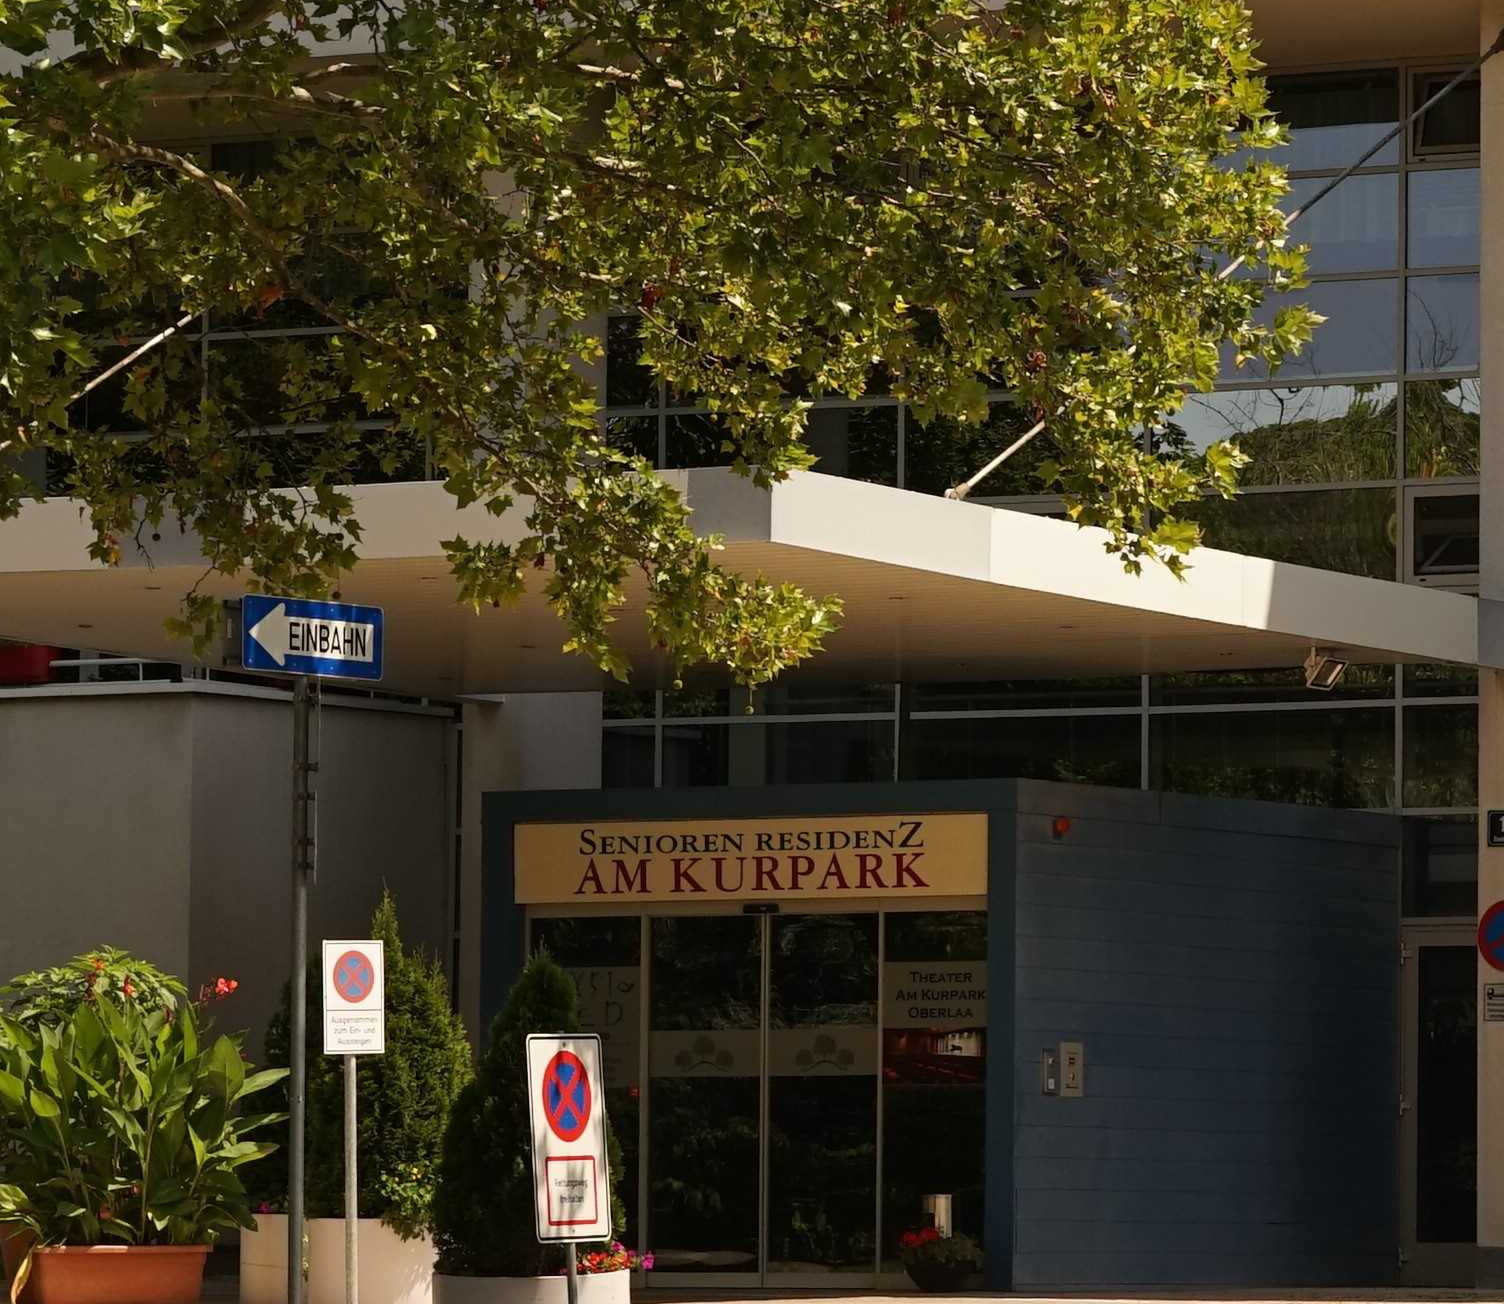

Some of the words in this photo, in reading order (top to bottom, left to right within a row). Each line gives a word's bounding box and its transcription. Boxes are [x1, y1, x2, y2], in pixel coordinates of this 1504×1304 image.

[289, 621, 367, 657] EINBAHN
[579, 829, 745, 856] SENIOREN
[754, 821, 925, 851] RESIDENZ
[573, 857, 653, 895] AM
[669, 851, 931, 893] KURPARK
